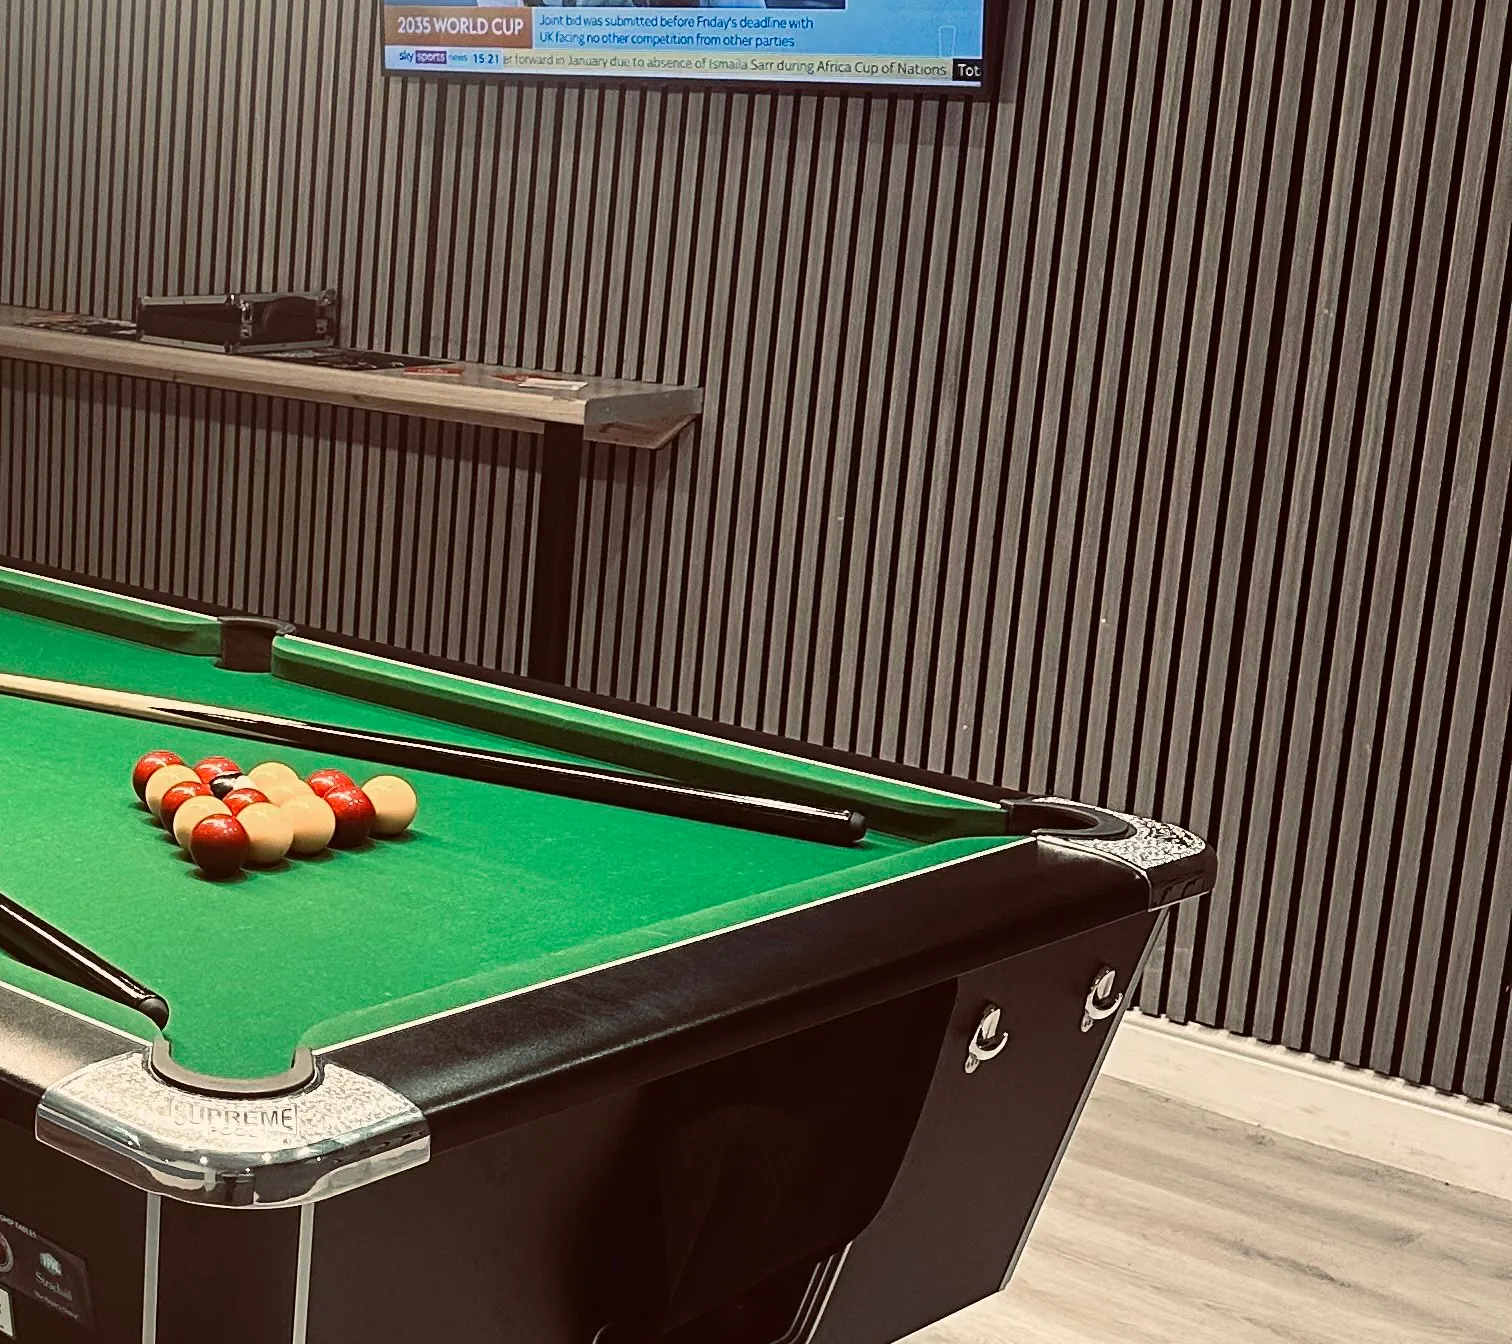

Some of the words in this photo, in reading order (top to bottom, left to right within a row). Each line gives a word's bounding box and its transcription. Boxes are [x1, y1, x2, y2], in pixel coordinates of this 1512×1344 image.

[398, 17, 431, 34] 2035
[433, 17, 488, 34] WORLD
[491, 18, 524, 36] CUP
[539, 15, 563, 26] Joint
[565, 15, 581, 25] bid
[584, 16, 603, 26] was
[605, 16, 657, 27] submitted
[660, 16, 695, 28] before
[697, 16, 737, 30] Friday's
[740, 16, 786, 29] deadline
[789, 17, 814, 29] with
[539, 32, 553, 43] UK
[556, 32, 585, 46] facing
[587, 34, 600, 44] no
[601, 33, 630, 44] other
[631, 33, 694, 47] competition
[696, 34, 721, 45] from
[723, 35, 752, 46] other
[755, 36, 795, 48] parties
[399, 50, 413, 63] sky
[417, 51, 445, 63] sports
[449, 54, 468, 62] news
[514, 54, 553, 65] forward
[556, 55, 565, 65] in
[569, 55, 607, 68] January
[610, 56, 630, 67] due
[632, 57, 644, 67] to
[646, 56, 693, 69] absence
[695, 57, 707, 69] of
[709, 58, 748, 70] Ismaila
[750, 59, 773, 71] Sarr
[777, 59, 814, 74] during
[816, 61, 852, 74] Africa
[854, 61, 878, 76] Cup
[881, 61, 895, 74] of
[897, 62, 947, 76] Nations
[174, 1103, 293, 1130] SUPREME
